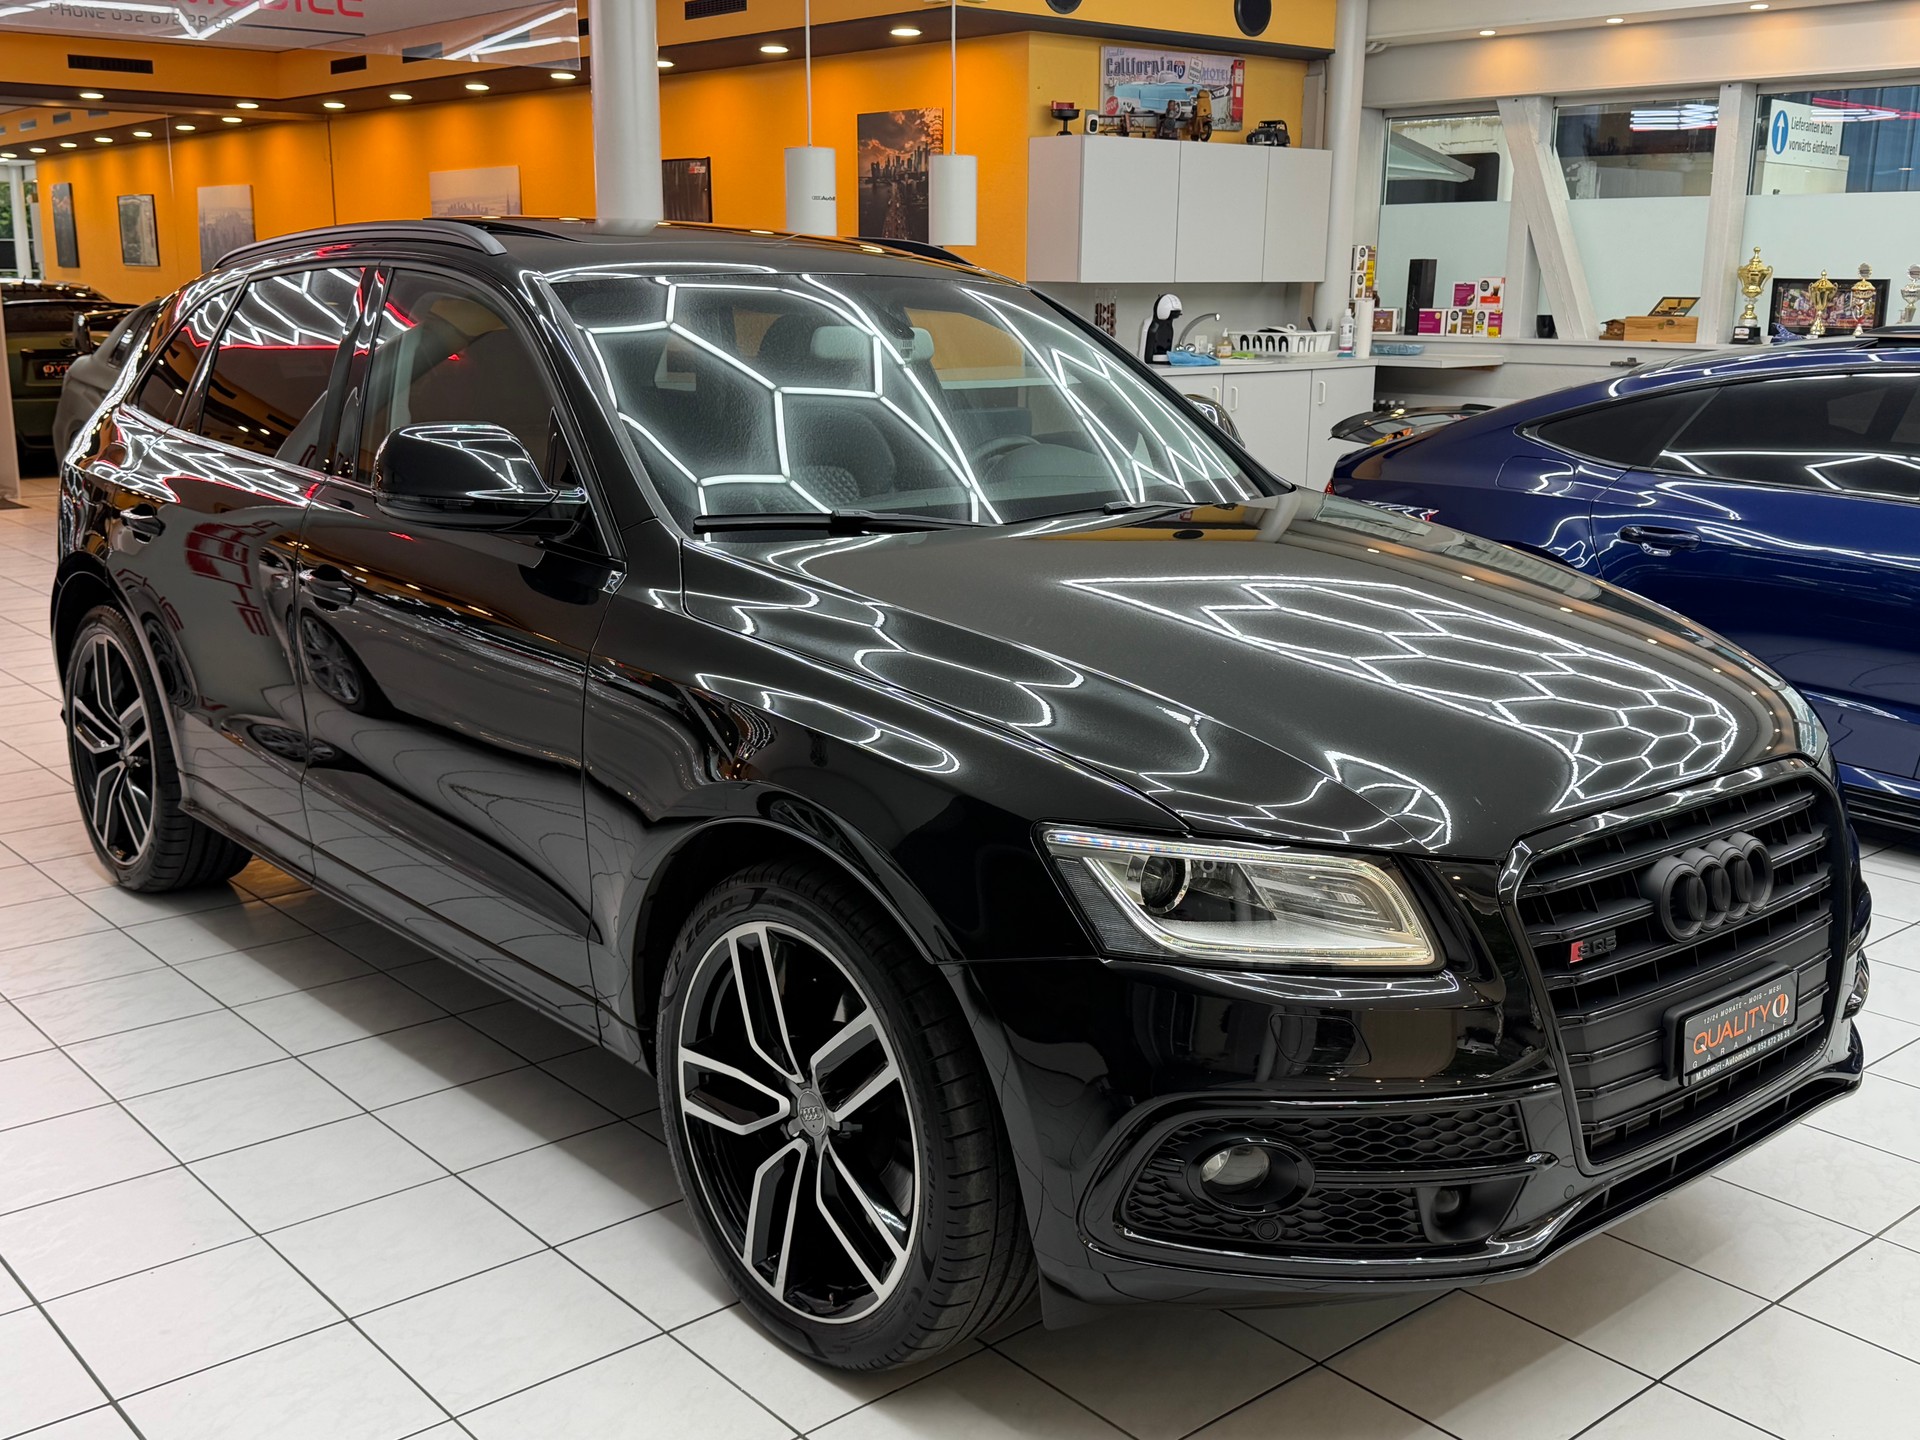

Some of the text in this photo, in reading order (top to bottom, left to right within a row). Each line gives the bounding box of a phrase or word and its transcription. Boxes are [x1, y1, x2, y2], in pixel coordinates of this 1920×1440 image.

[1106, 57, 1173, 76] California
[1791, 117, 1833, 135] Lieferanten bitte
[1789, 139, 1839, 155] vorwärts einfahren!
[684, 896, 734, 954] ZERO
[1703, 1013, 1719, 1025] 12/24
[1720, 1002, 1742, 1017] MONATE
[1748, 992, 1763, 1004] MOIS
[1768, 984, 1782, 995] MESI
[1693, 1000, 1772, 1055] QUALITY
[1725, 1047, 1756, 1067] Automobile
[1758, 1041, 1767, 1051] 052
